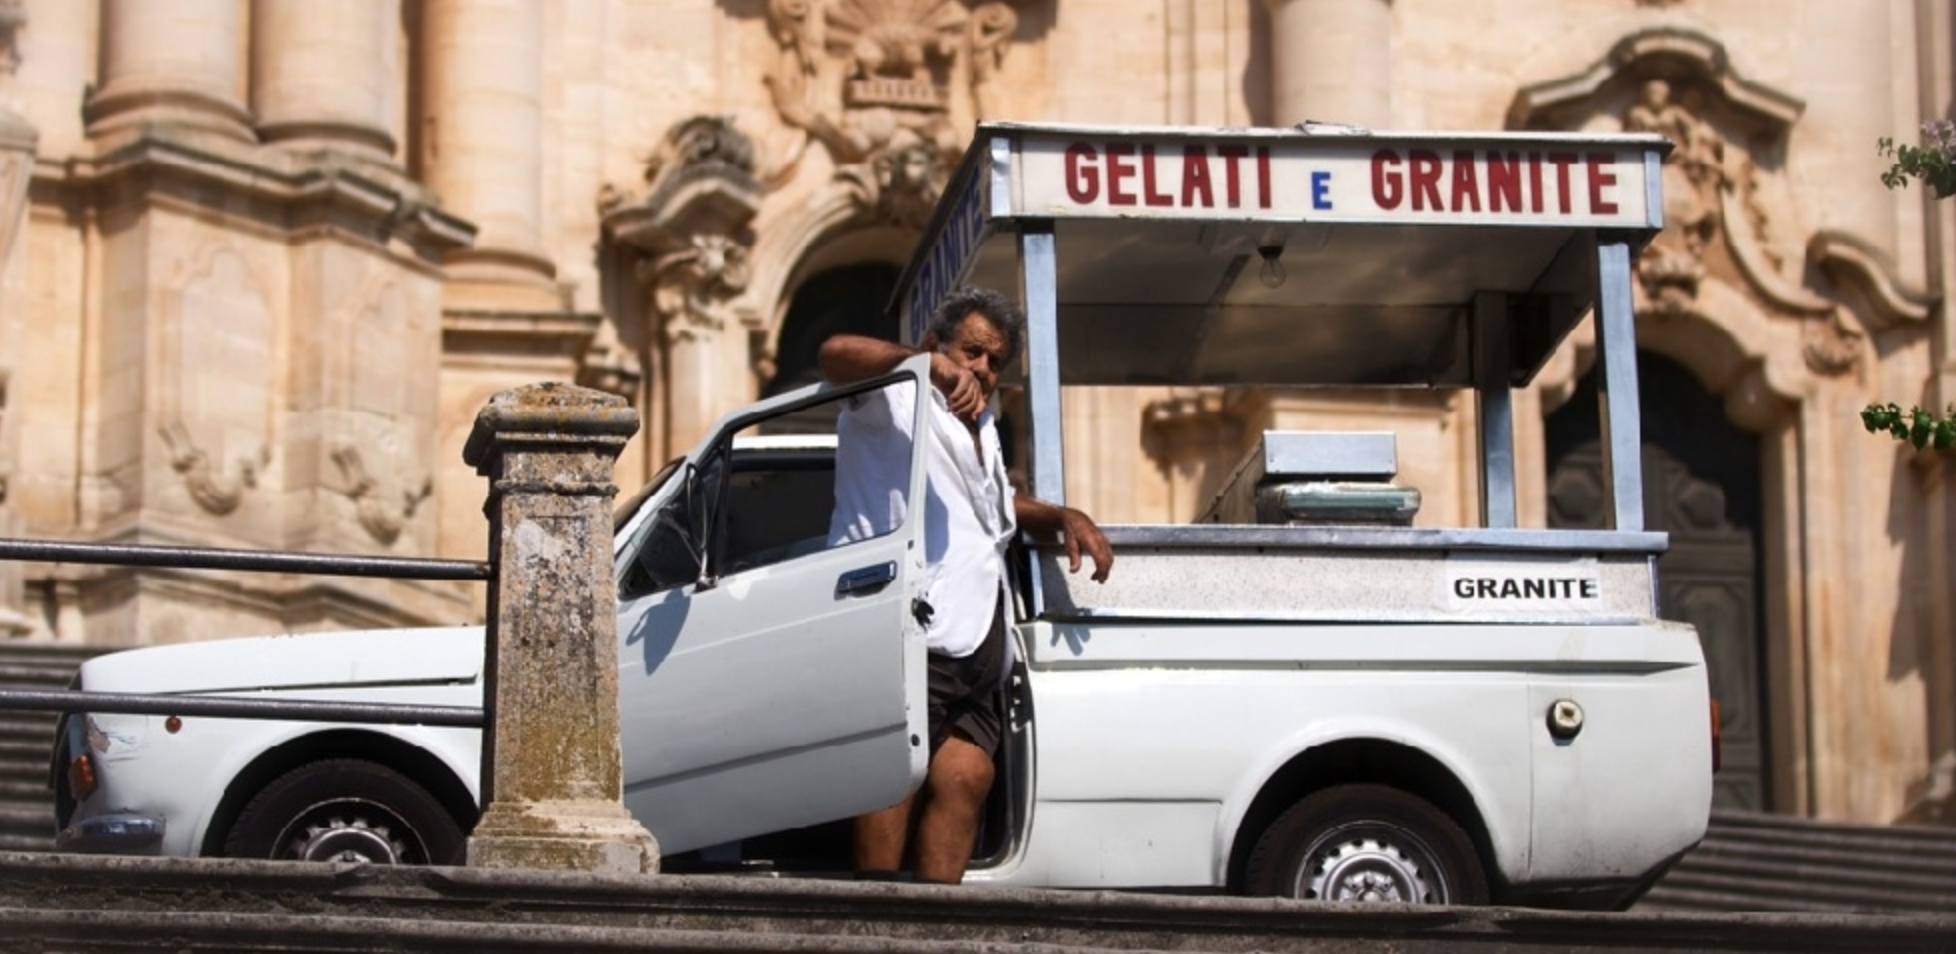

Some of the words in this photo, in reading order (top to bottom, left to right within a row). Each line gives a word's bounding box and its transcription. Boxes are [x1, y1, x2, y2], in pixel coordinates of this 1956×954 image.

[1064, 141, 1272, 209] GELATI
[1311, 171, 1333, 210] E
[1371, 148, 1619, 215] GRANITE
[1454, 578, 1598, 598] GRANITE
